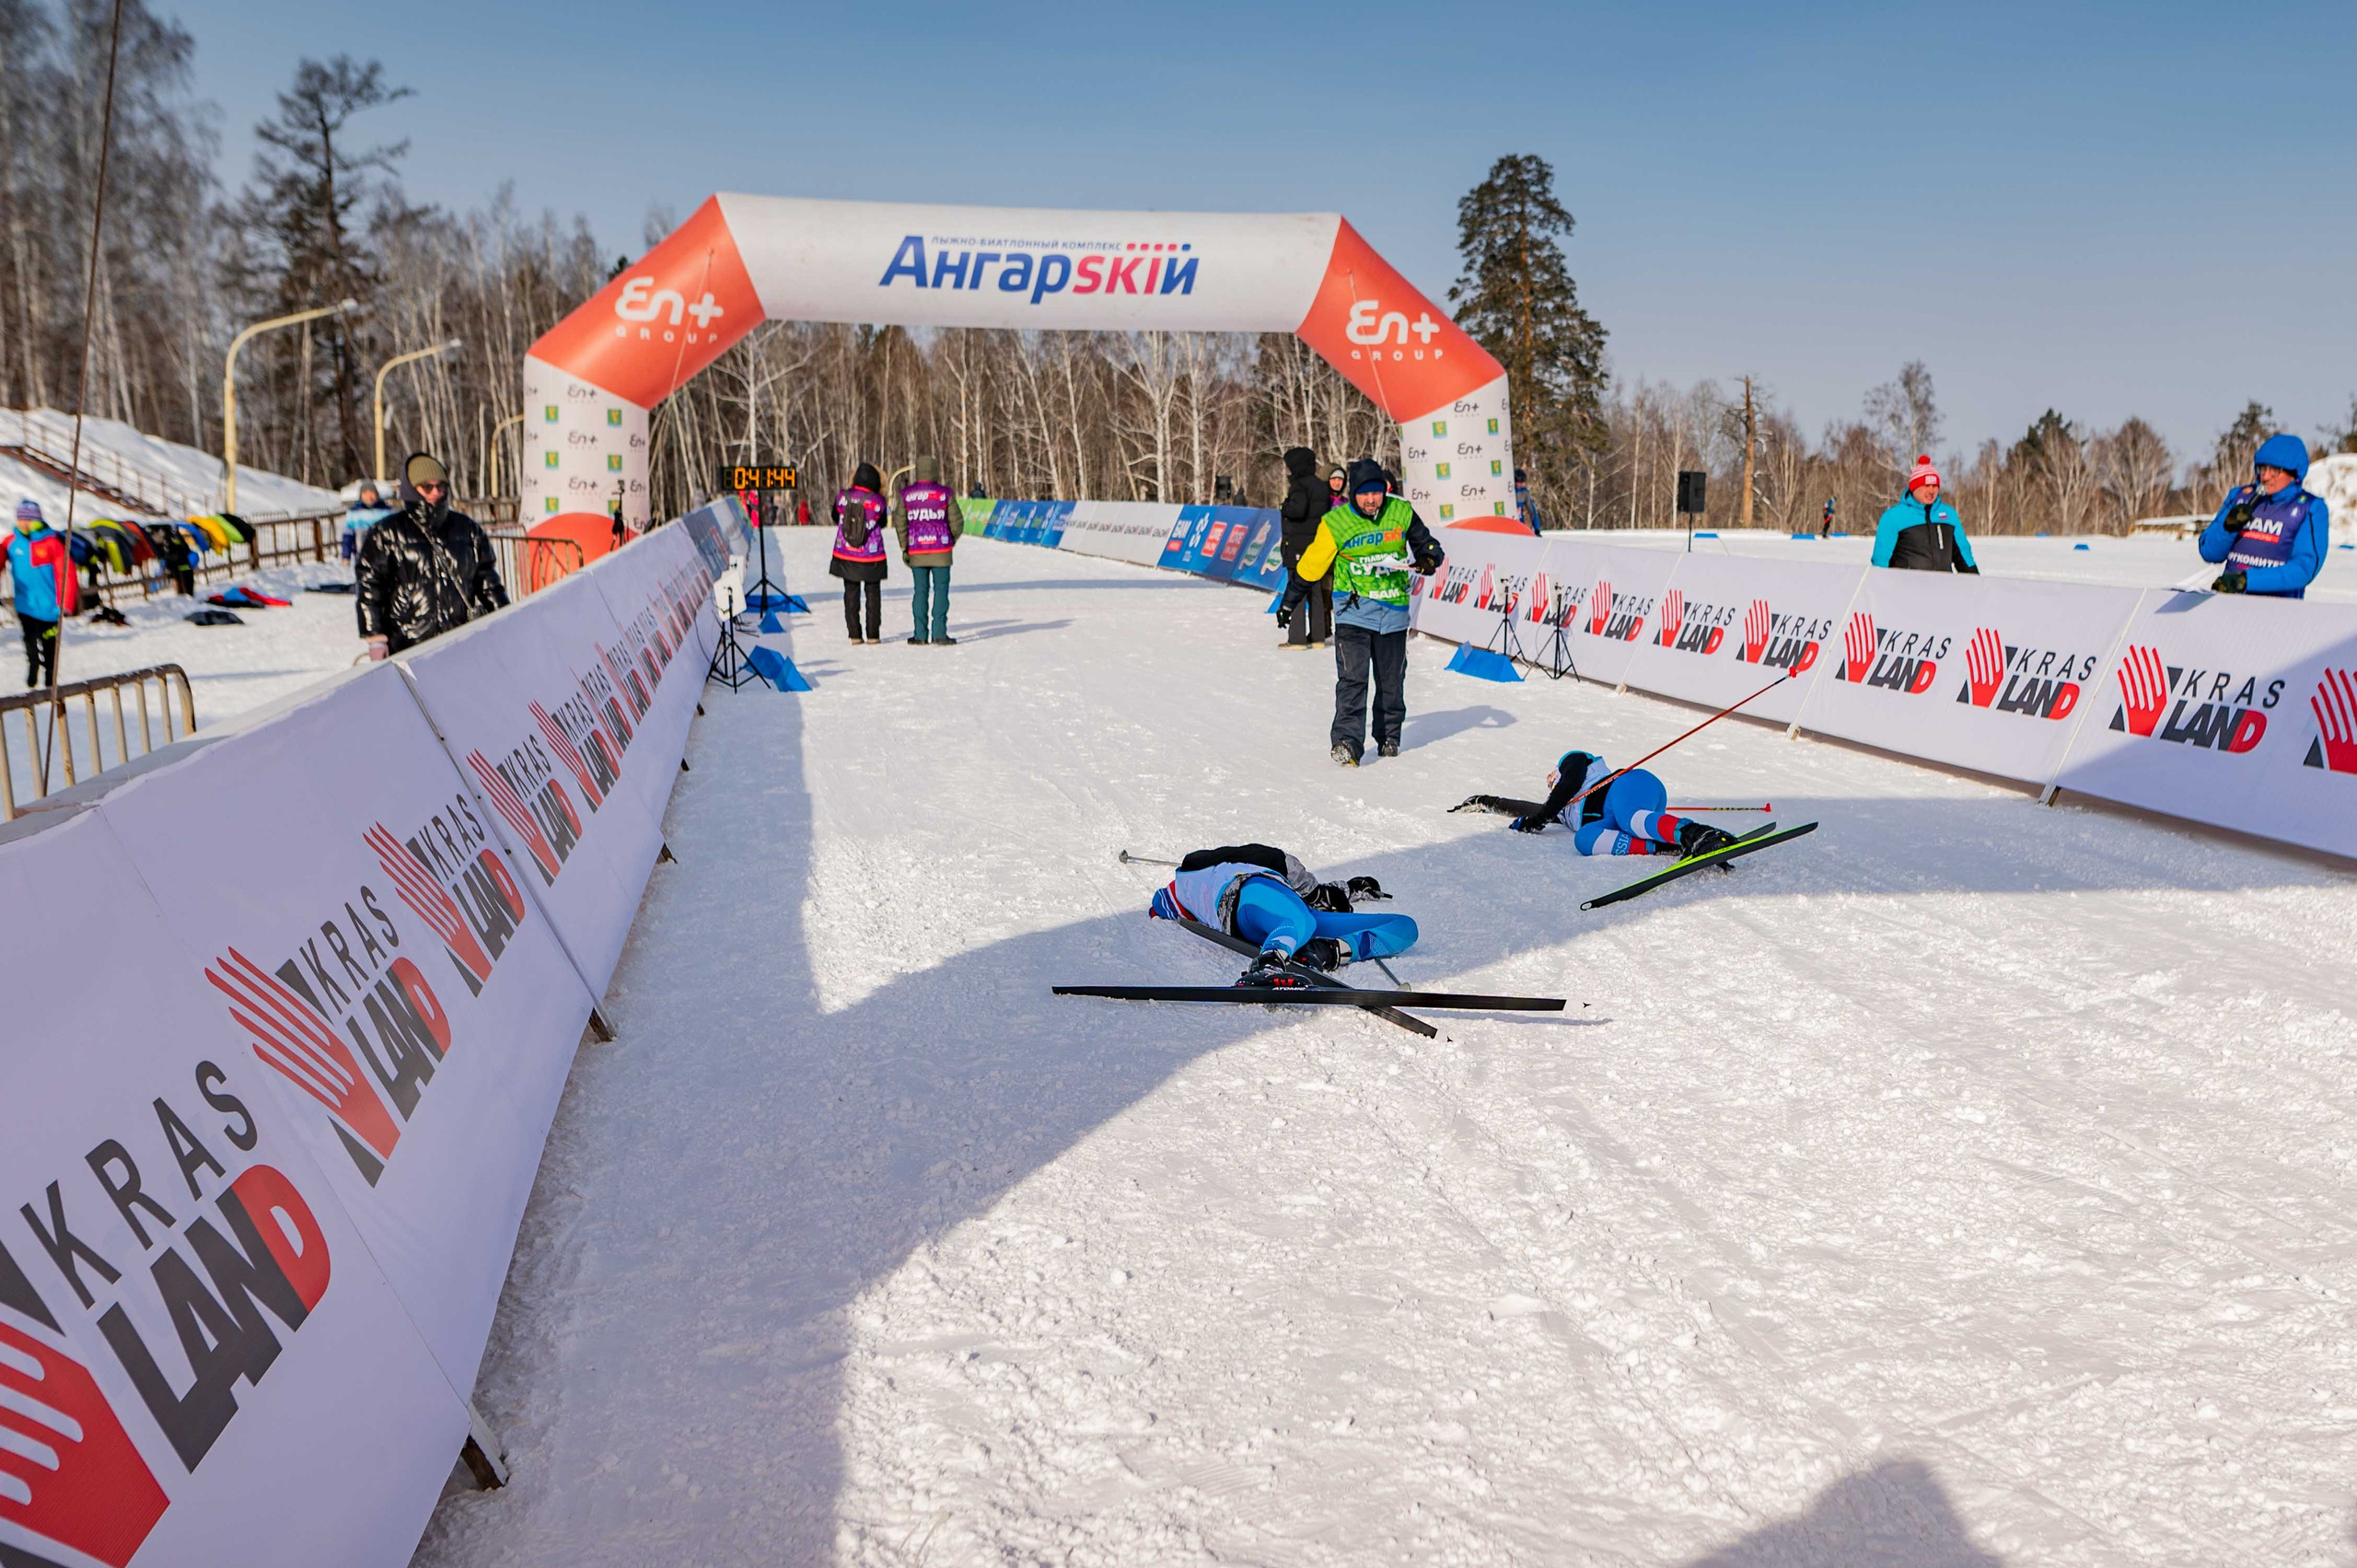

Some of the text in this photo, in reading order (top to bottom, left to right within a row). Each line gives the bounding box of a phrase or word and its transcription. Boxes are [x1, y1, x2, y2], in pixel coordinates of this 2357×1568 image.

[932, 235, 1122, 251] ЛЫЖНО-БИАТЛОННЫЙ КОМПЛЕКС
[615, 325, 718, 344] GROUP
[1351, 349, 1444, 361] GROUP
[735, 467, 795, 489] 0:41:44
[907, 508, 946, 521] СУДЬЯ
[2244, 517, 2283, 536] АМ
[1451, 566, 1478, 583] KRAS
[1508, 575, 1527, 592] RAS
[1369, 588, 1399, 598] БАМ
[1441, 580, 1469, 604] LAND
[1563, 586, 1586, 604] RAS
[1618, 594, 1654, 616] KRAS
[1604, 612, 1643, 642] LAND
[1689, 603, 1736, 626] KRAS
[1774, 614, 1832, 641] KRAS
[1676, 622, 1724, 656] LAND
[1763, 636, 1819, 672] LAND
[1885, 631, 1952, 659] KRAS
[1867, 654, 1937, 694] LAND
[2015, 648, 2097, 681] KRAS
[1996, 674, 2081, 720] LAND
[2182, 668, 2286, 709] KRAS
[557, 691, 595, 743] KRAS
[601, 696, 633, 751] LAND
[2160, 699, 2268, 754] LAND
[505, 734, 552, 799] KRAS
[578, 729, 621, 797] LAND
[418, 794, 485, 881] KRAS
[530, 778, 583, 865] LAND
[452, 849, 526, 962] LAND
[299, 886, 400, 1016] KRAS
[345, 957, 452, 1123] LAND
[19, 1060, 258, 1310] KRAS
[96, 1164, 331, 1475] LAND
